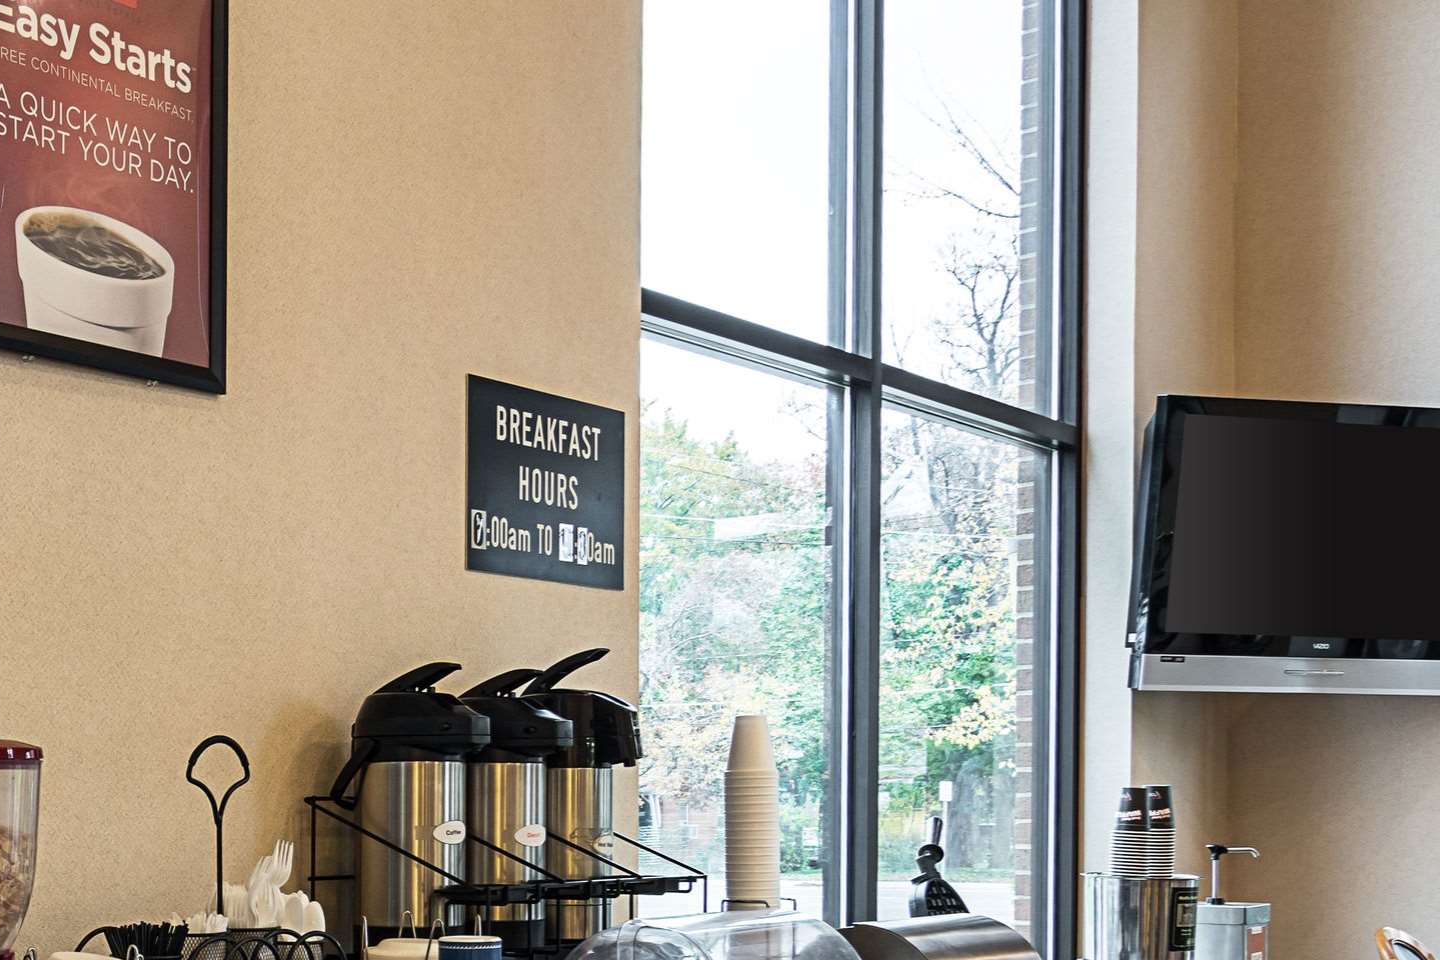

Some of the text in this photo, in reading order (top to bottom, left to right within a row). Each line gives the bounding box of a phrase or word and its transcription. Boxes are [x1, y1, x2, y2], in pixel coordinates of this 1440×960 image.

[31, 57, 120, 98] CONTINENTAL
[89, 22, 192, 94] Starts
[19, 91, 98, 137] QUICK
[105, 117, 157, 154] WAY
[164, 136, 192, 165] TO
[78, 136, 143, 178] YOUR
[149, 159, 195, 194] DAY.
[496, 404, 602, 462] BREAKFAST
[518, 465, 580, 511] HOURS
[536, 523, 553, 556] TO
